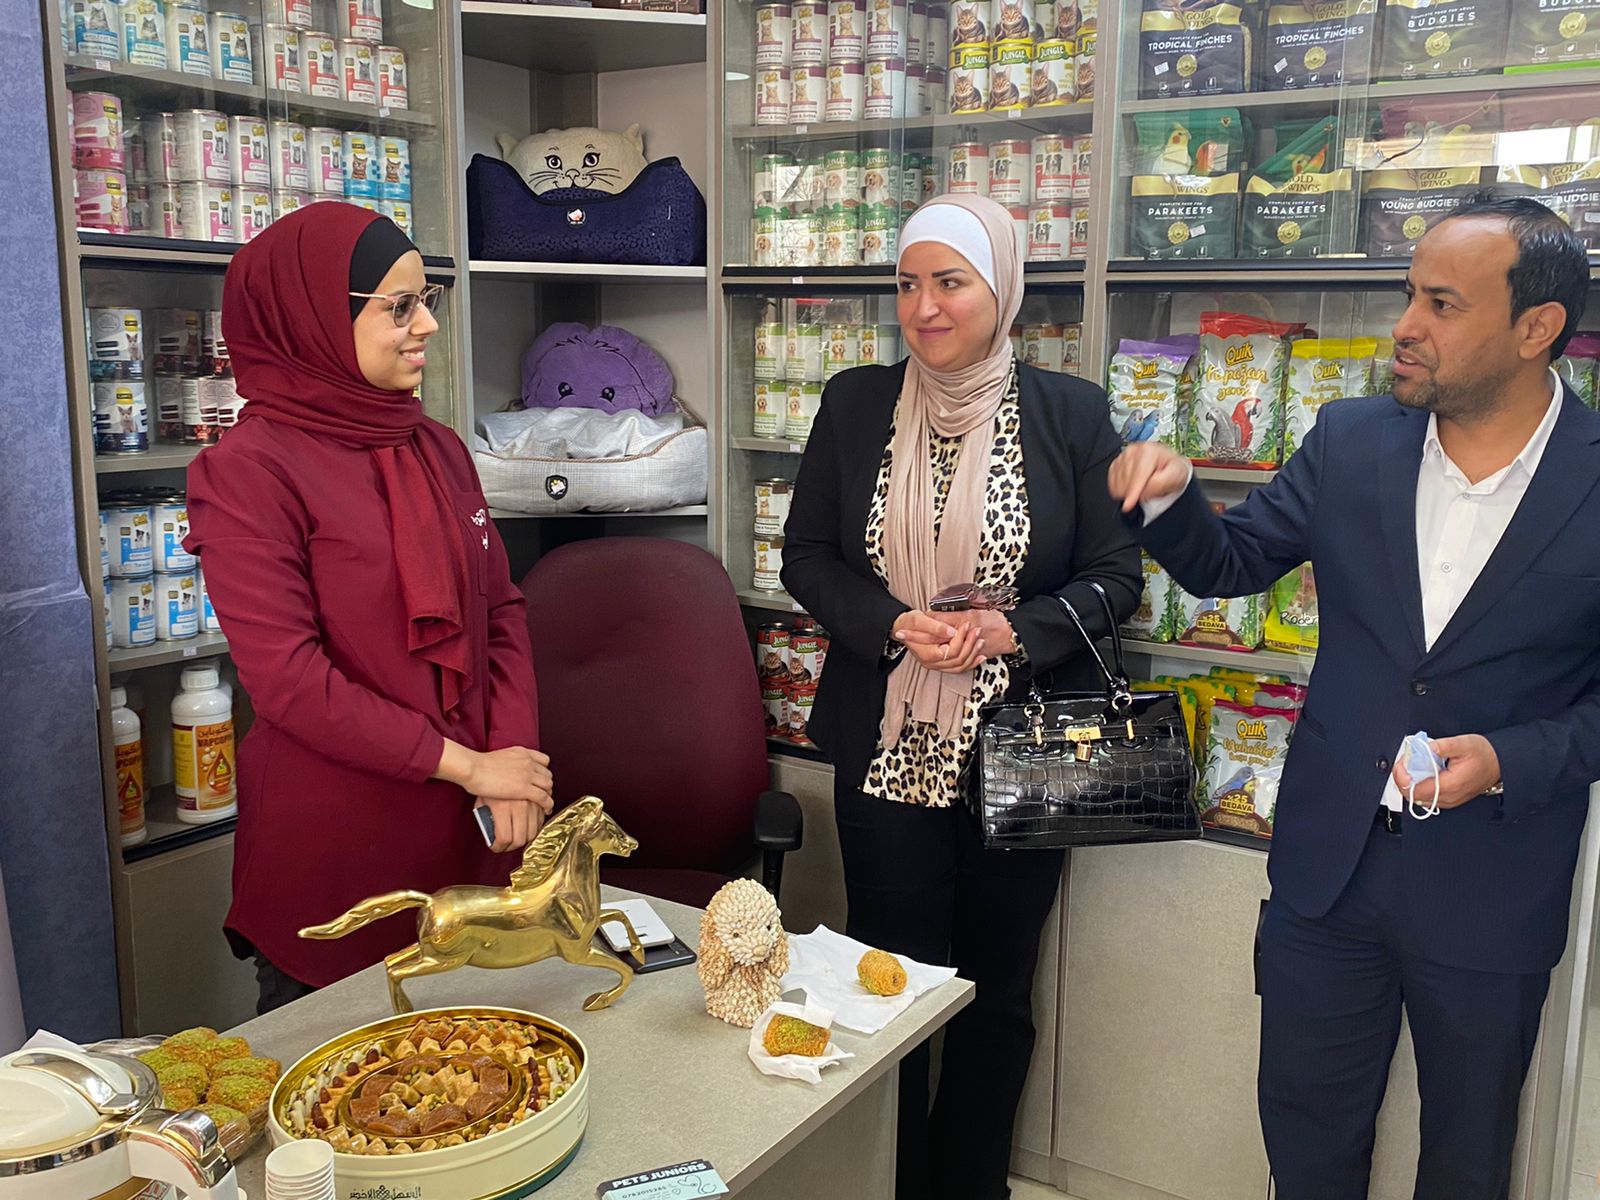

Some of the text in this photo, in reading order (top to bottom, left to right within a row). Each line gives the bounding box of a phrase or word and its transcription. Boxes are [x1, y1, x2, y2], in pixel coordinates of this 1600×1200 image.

[1186, 10, 1211, 21] GOLD
[1407, 12, 1476, 28] BUDGIES
[1275, 32, 1320, 44] TROPICAL
[1324, 26, 1364, 39] FINCHES
[1040, 44, 1065, 59] JUNGLE
[1148, 41, 1193, 52] TROPICAL
[965, 54, 988, 65] JUNGLE
[1002, 49, 1026, 62] JUNGLE
[1419, 170, 1448, 181] GOLD
[1287, 183, 1321, 192] WINGS
[1420, 178, 1452, 188] WINGS
[1176, 185, 1210, 194] WINGS
[1380, 198, 1460, 210] YOUNG BUDGIES
[1148, 206, 1213, 216] PARAKEETS
[1257, 205, 1326, 215] PARAKEETS
[1225, 341, 1255, 367] Quik
[1312, 361, 1345, 383] Quik
[1198, 621, 1226, 629] BEDAVA
[1237, 719, 1267, 740] Quik
[1221, 801, 1252, 812] BEDAVA
[611, 1162, 707, 1189] PETS JUNIORS
